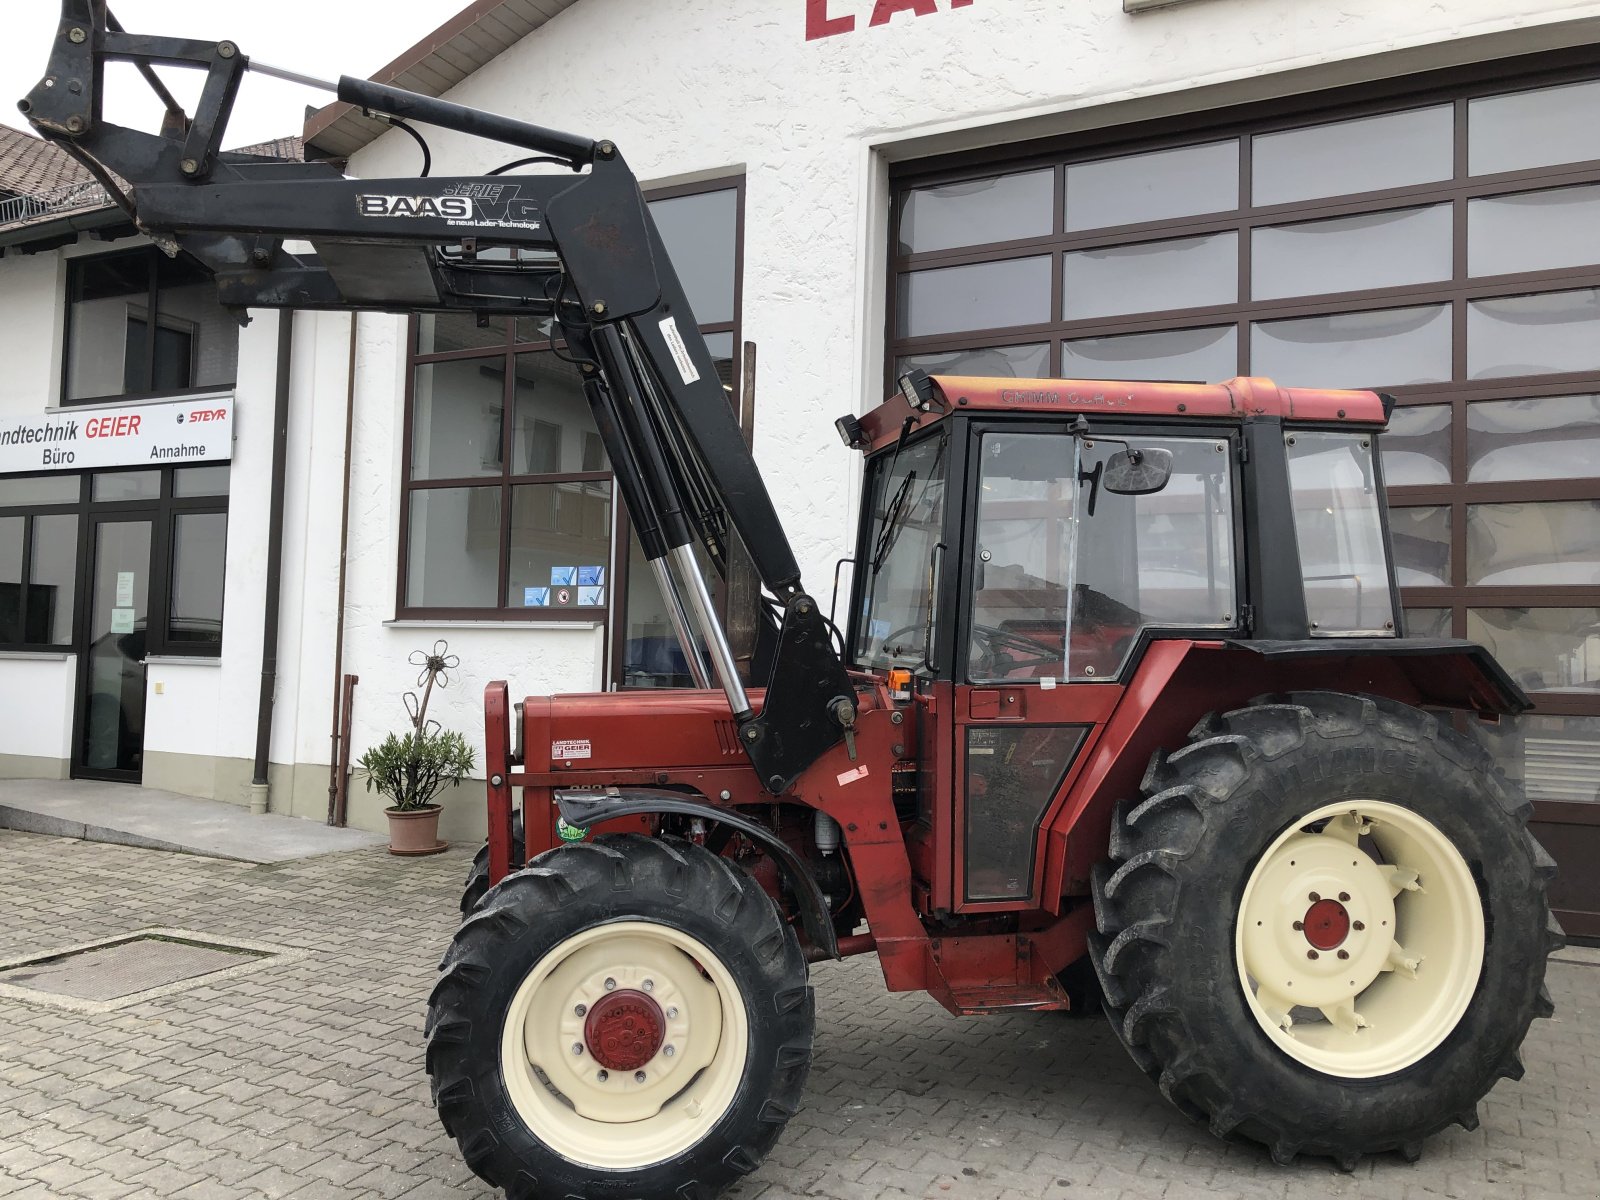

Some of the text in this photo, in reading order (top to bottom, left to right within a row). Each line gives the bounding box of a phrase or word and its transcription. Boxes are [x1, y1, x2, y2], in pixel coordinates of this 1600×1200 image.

[361, 197, 468, 217] BAAS
[189, 409, 226, 423] STEYR
[0, 415, 142, 446] ndtechnik GEIER
[42, 443, 206, 465] Büro Annahme
